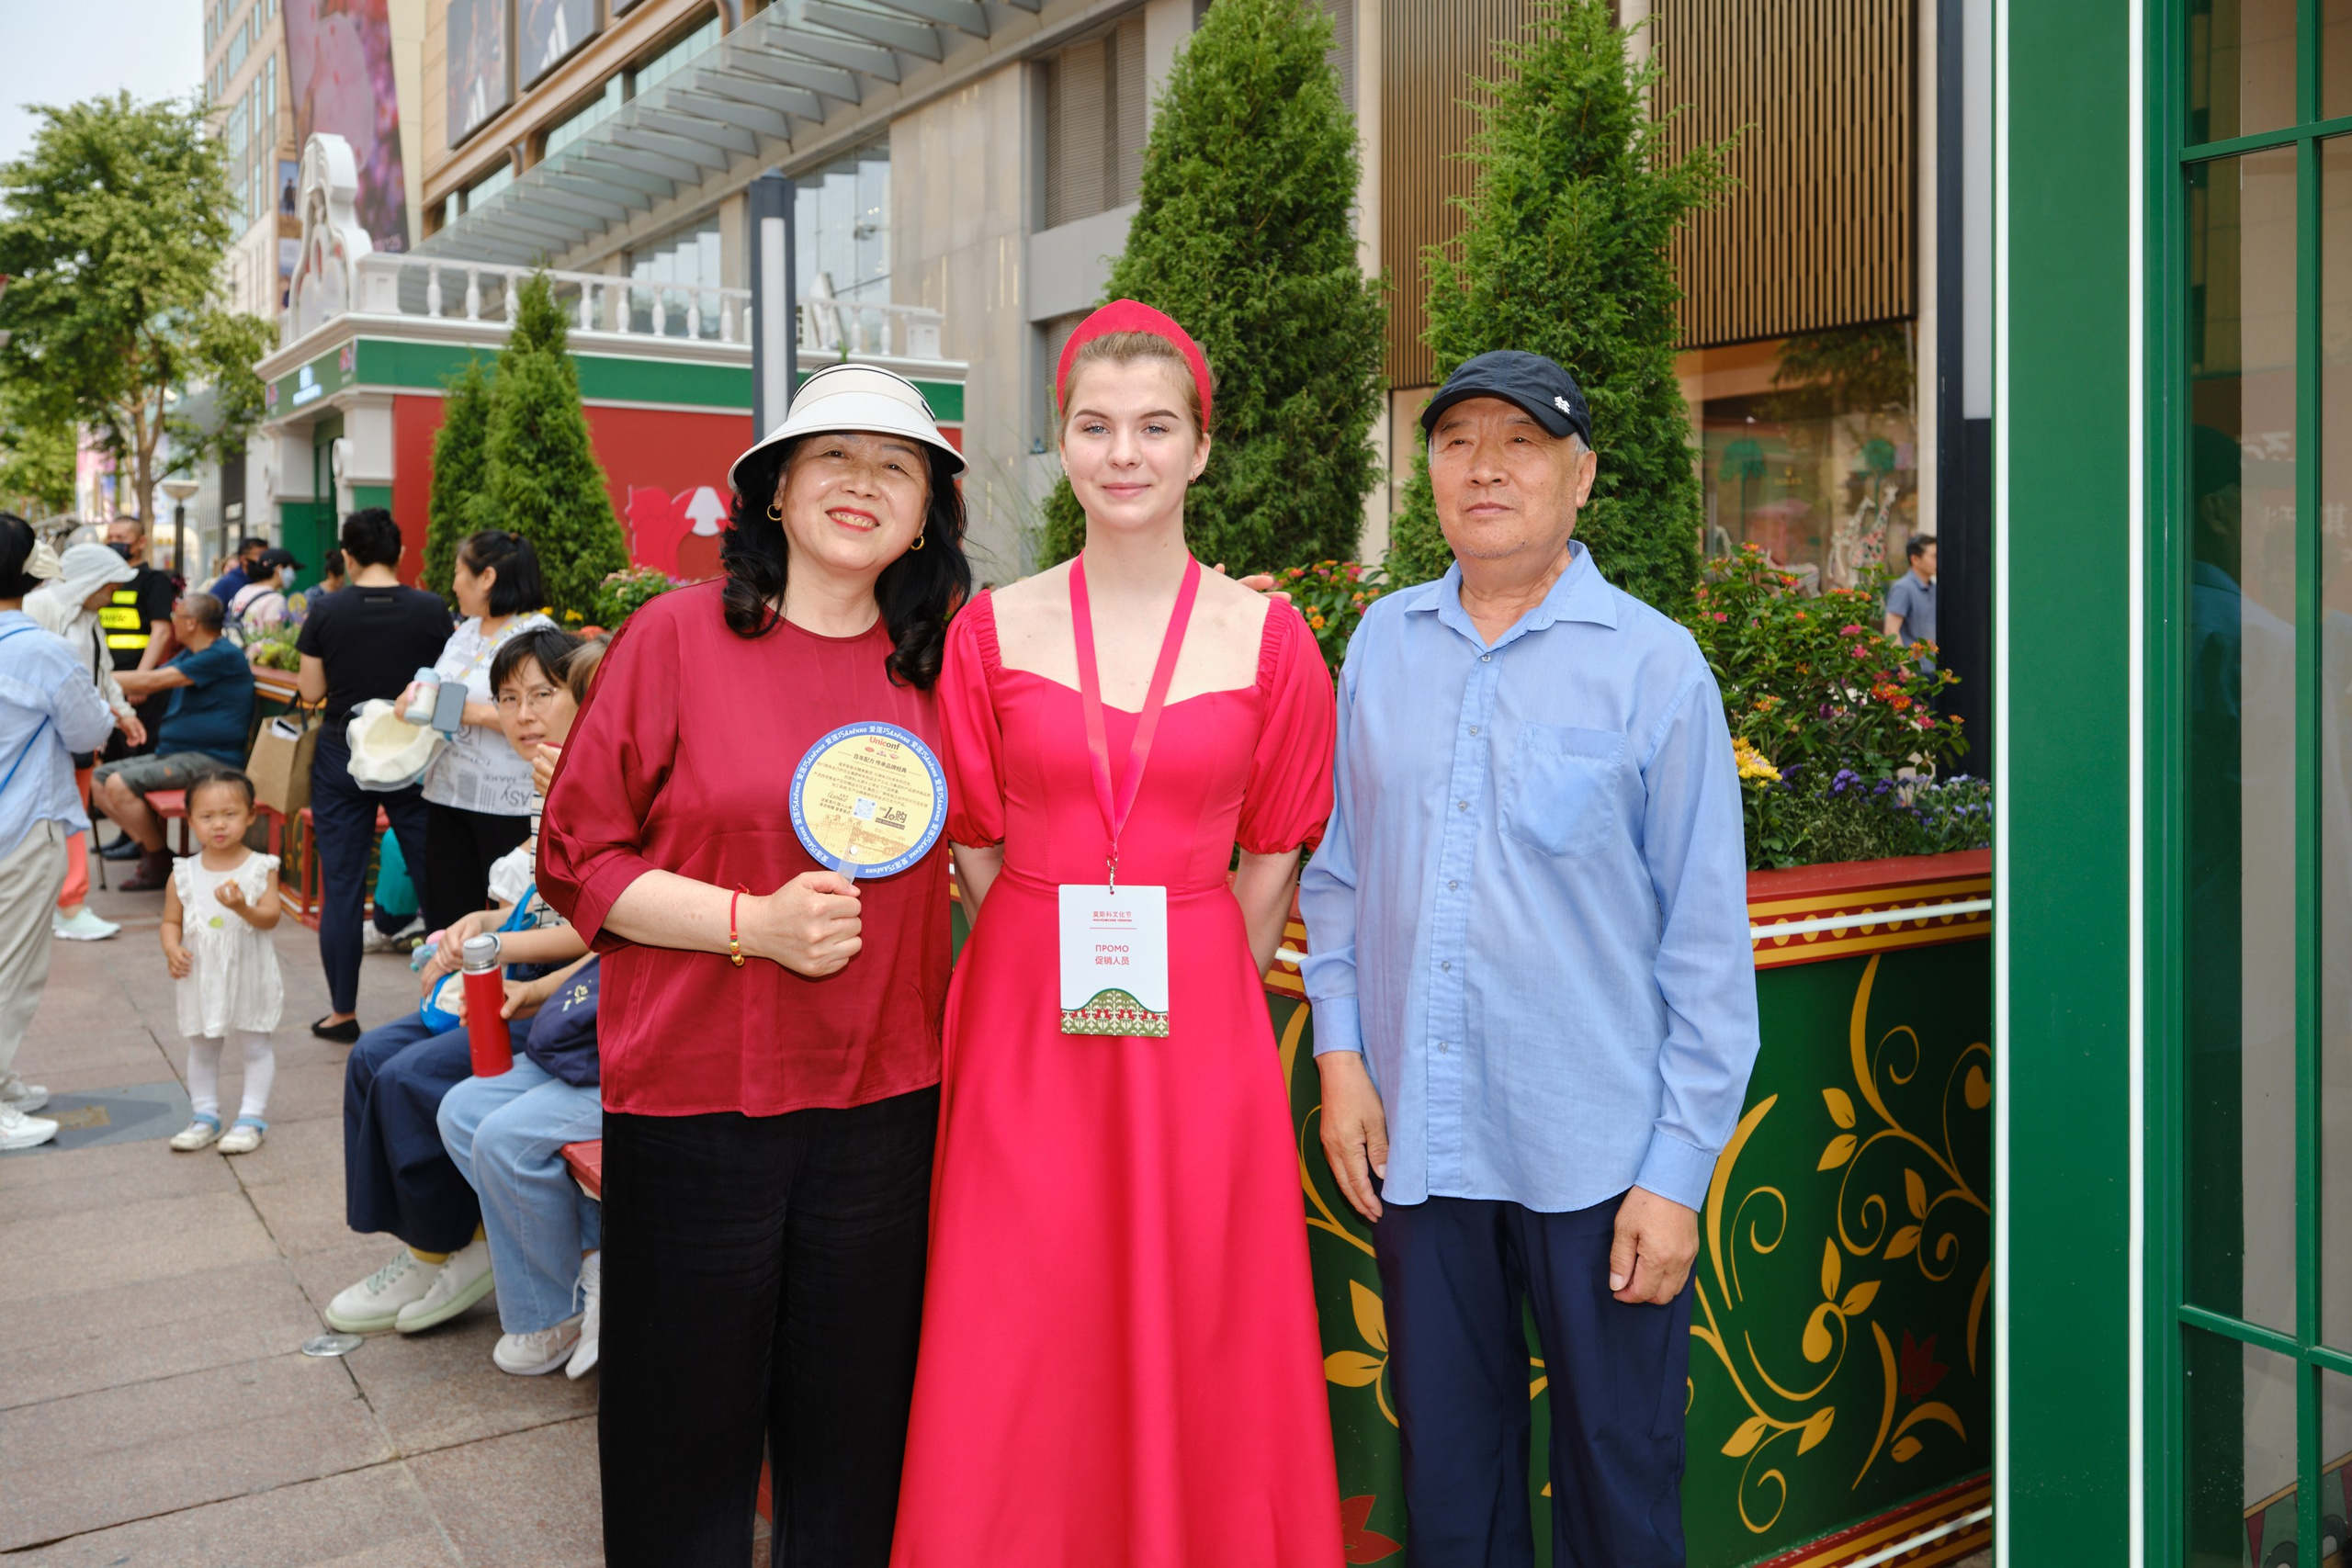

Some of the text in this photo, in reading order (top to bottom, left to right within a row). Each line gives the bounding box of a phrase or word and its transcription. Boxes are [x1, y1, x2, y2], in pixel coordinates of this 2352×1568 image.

[869, 736, 901, 750] Uniconf
[1092, 910, 1132, 919] 莫斯科文化节
[1095, 944, 1129, 953] ПРОМО
[1095, 955, 1129, 965] 促销人员
